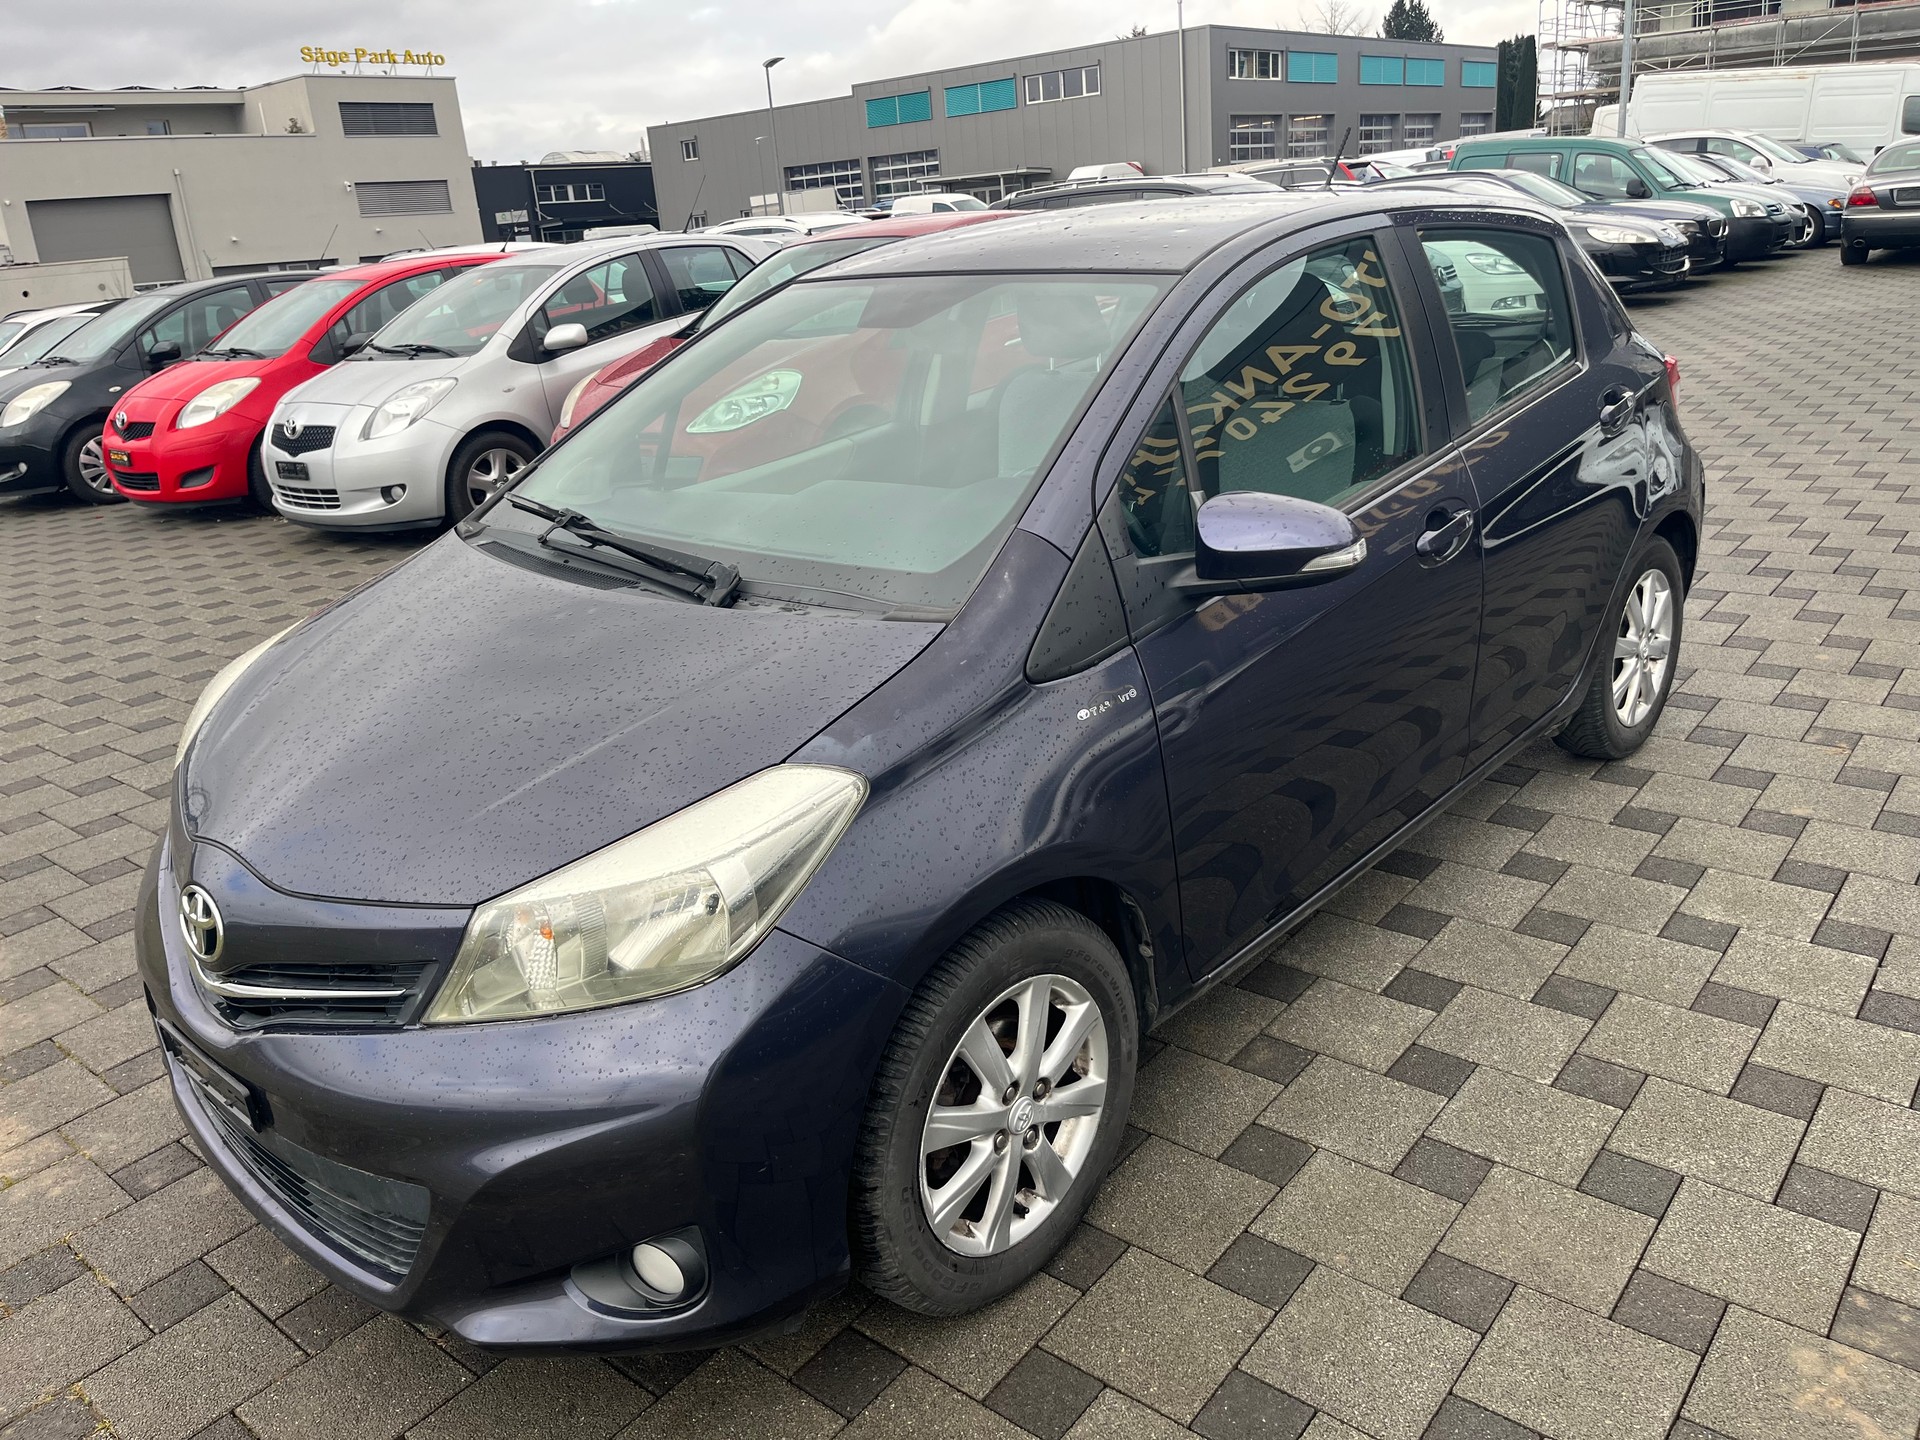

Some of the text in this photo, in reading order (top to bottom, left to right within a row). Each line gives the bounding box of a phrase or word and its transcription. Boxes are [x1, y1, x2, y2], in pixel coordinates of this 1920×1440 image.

[300, 46, 446, 67] Säge Park Auto
